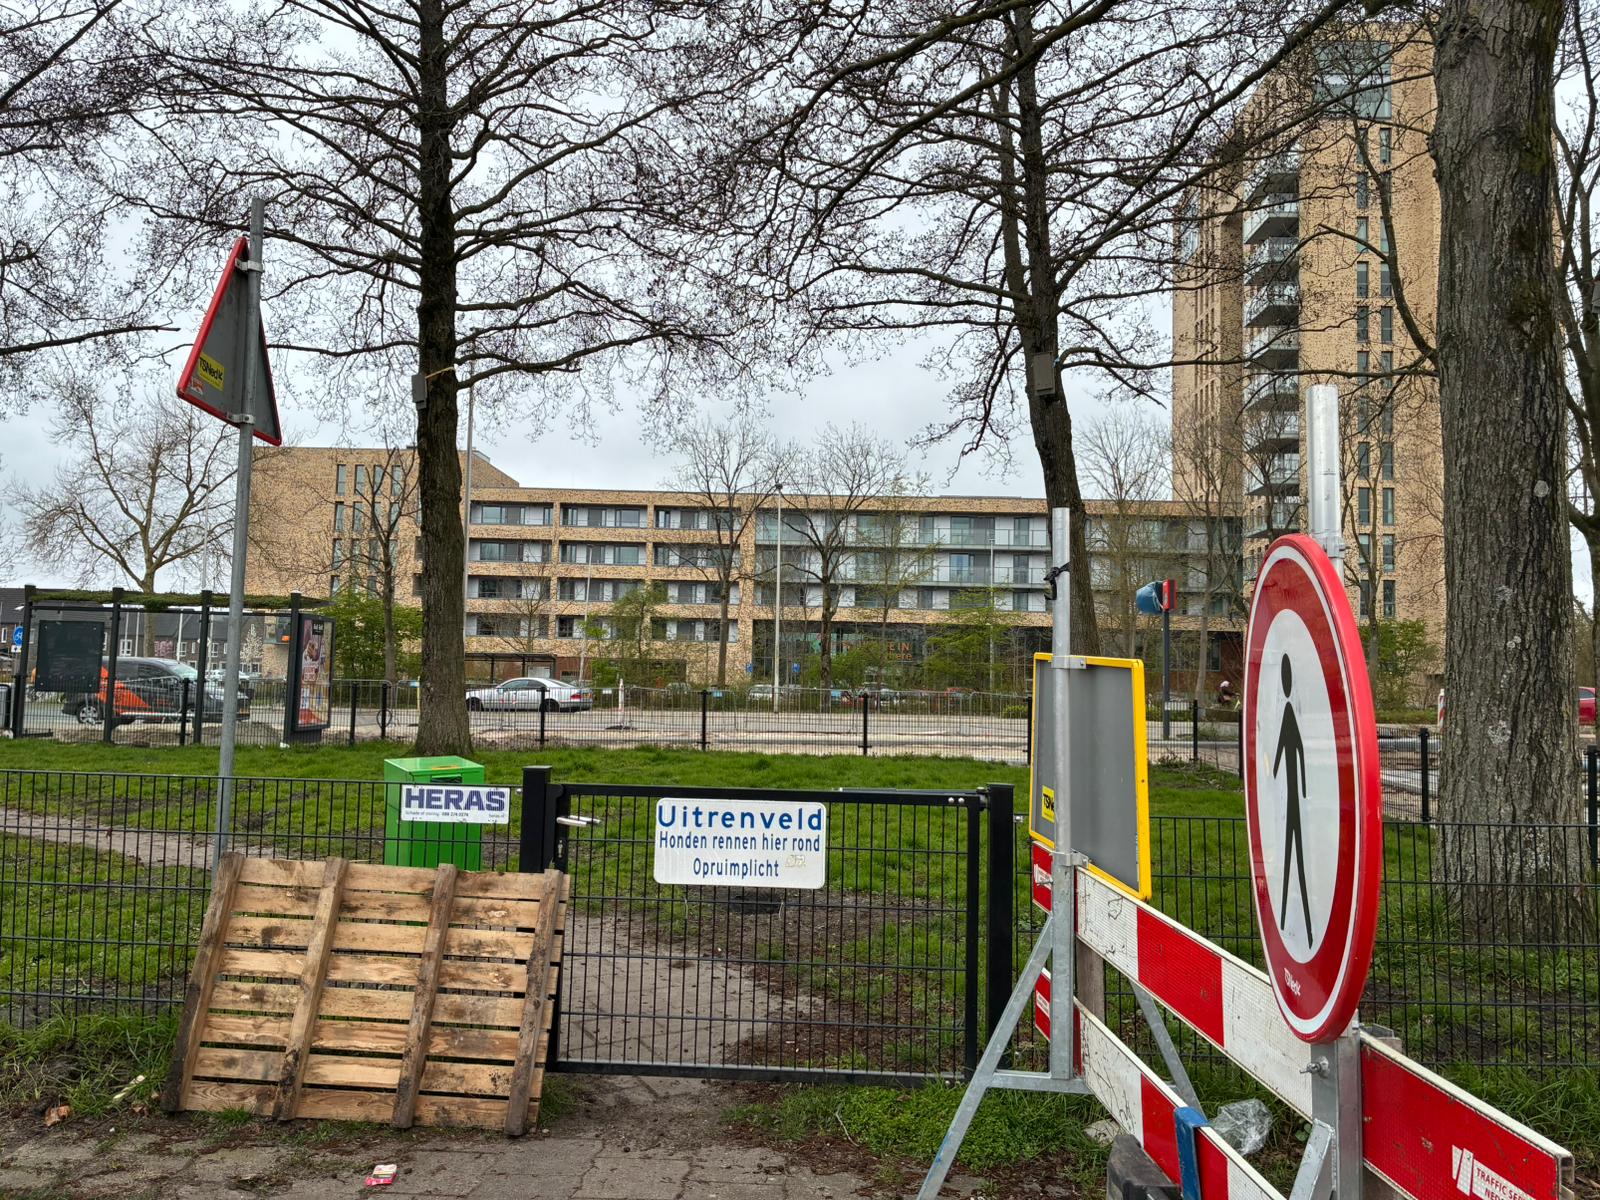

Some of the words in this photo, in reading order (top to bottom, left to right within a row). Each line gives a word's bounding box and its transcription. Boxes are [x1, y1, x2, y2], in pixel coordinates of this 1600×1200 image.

[405, 788, 505, 811] HERAS
[658, 805, 822, 831] Uitrenveld
[659, 831, 707, 849] Honden
[712, 835, 757, 850] rennen
[762, 832, 788, 851] hier
[792, 835, 820, 852] rond
[693, 857, 779, 879] Opruimplicht
[1476, 1167, 1508, 1195] TRAFFIC
[1485, 1187, 1505, 1200] NED
